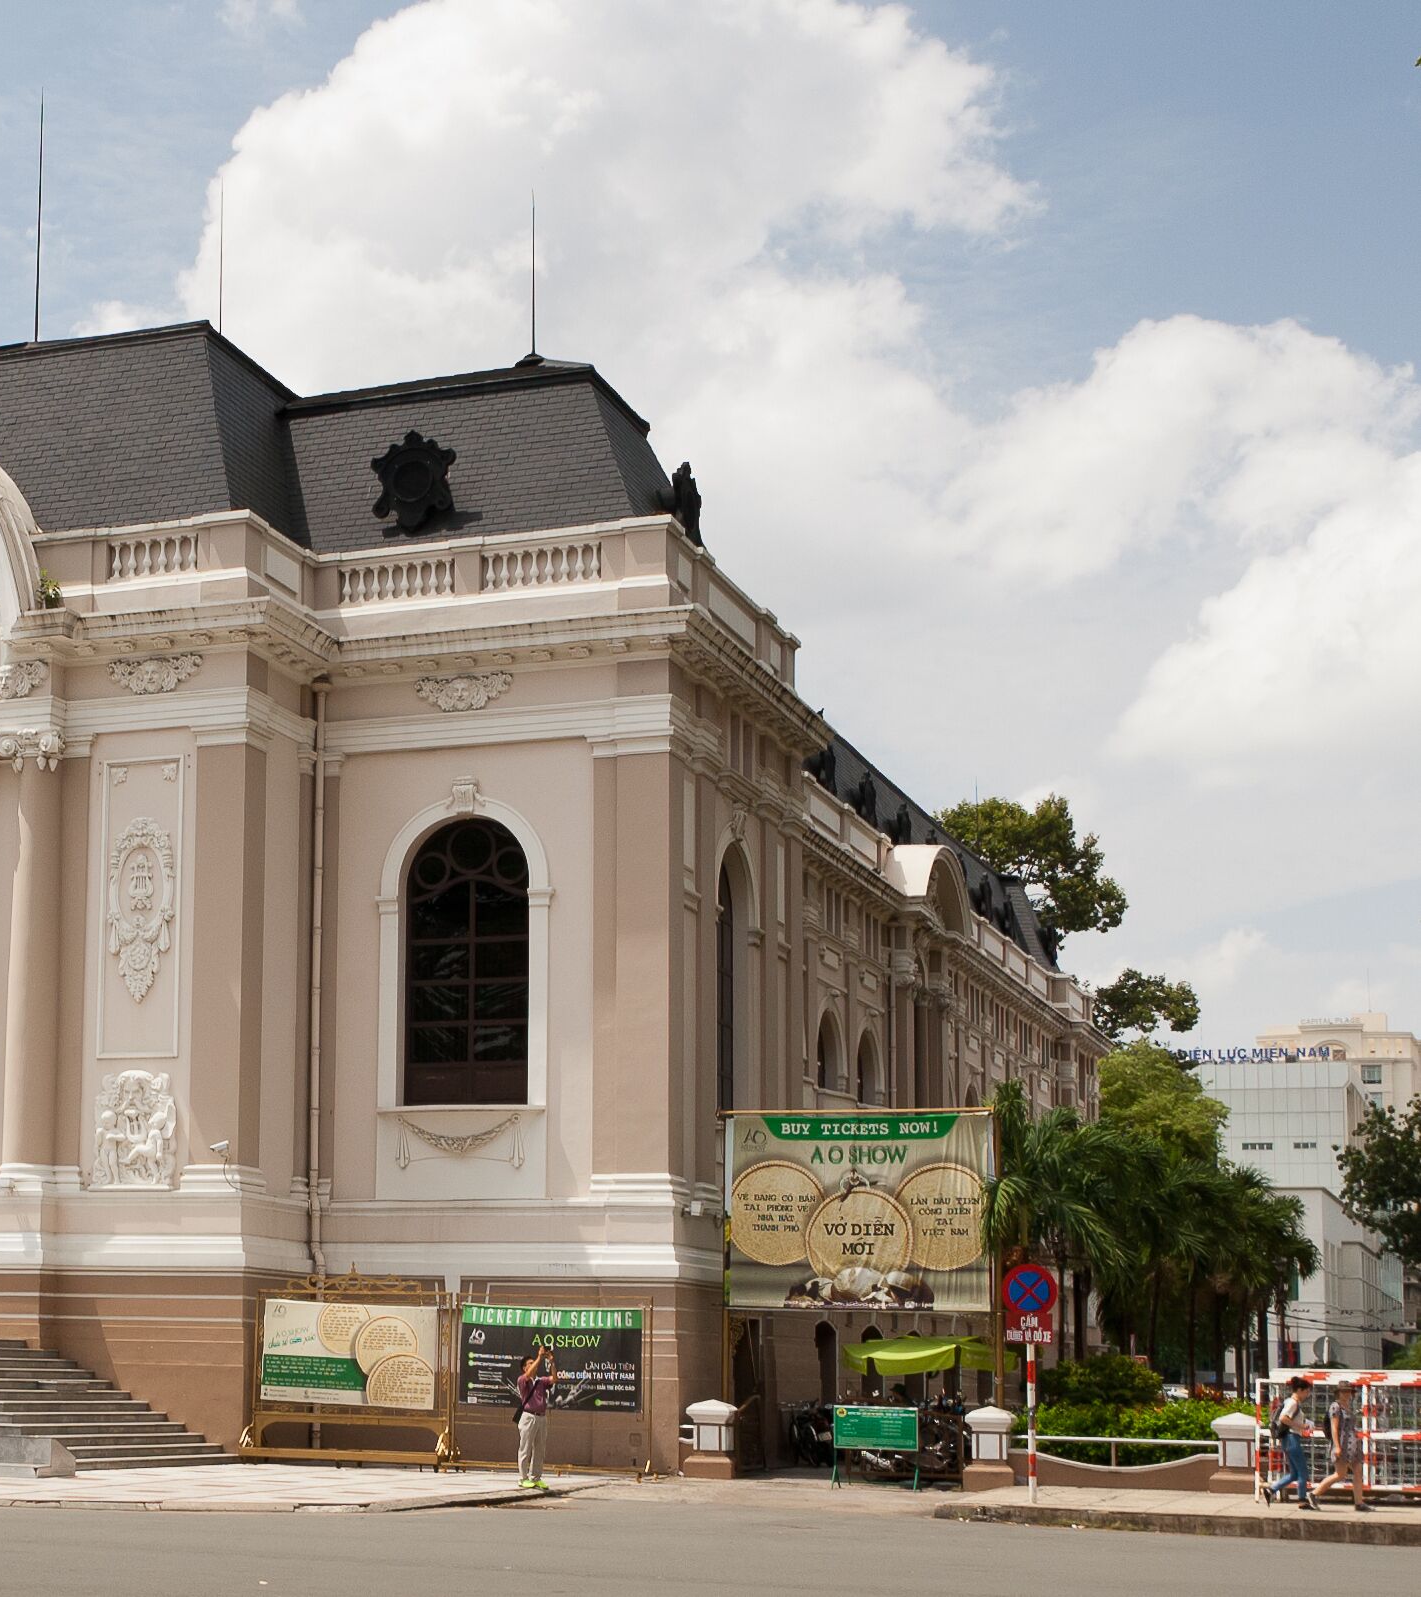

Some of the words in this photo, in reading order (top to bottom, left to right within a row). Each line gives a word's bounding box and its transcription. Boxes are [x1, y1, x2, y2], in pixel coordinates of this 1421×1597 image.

[1296, 1046, 1331, 1058] NAM
[781, 1123, 811, 1135] BUY
[821, 1123, 889, 1135] TICKETS
[899, 1121, 938, 1134] NOW!
[823, 1216, 847, 1236] VỞ
[851, 1216, 895, 1236] DIỄN
[842, 1237, 875, 1255] MỚI
[471, 1306, 523, 1325] TICKET
[530, 1310, 562, 1327] NOW
[571, 1311, 633, 1327] SELLING
[556, 1334, 601, 1348] SHOW
